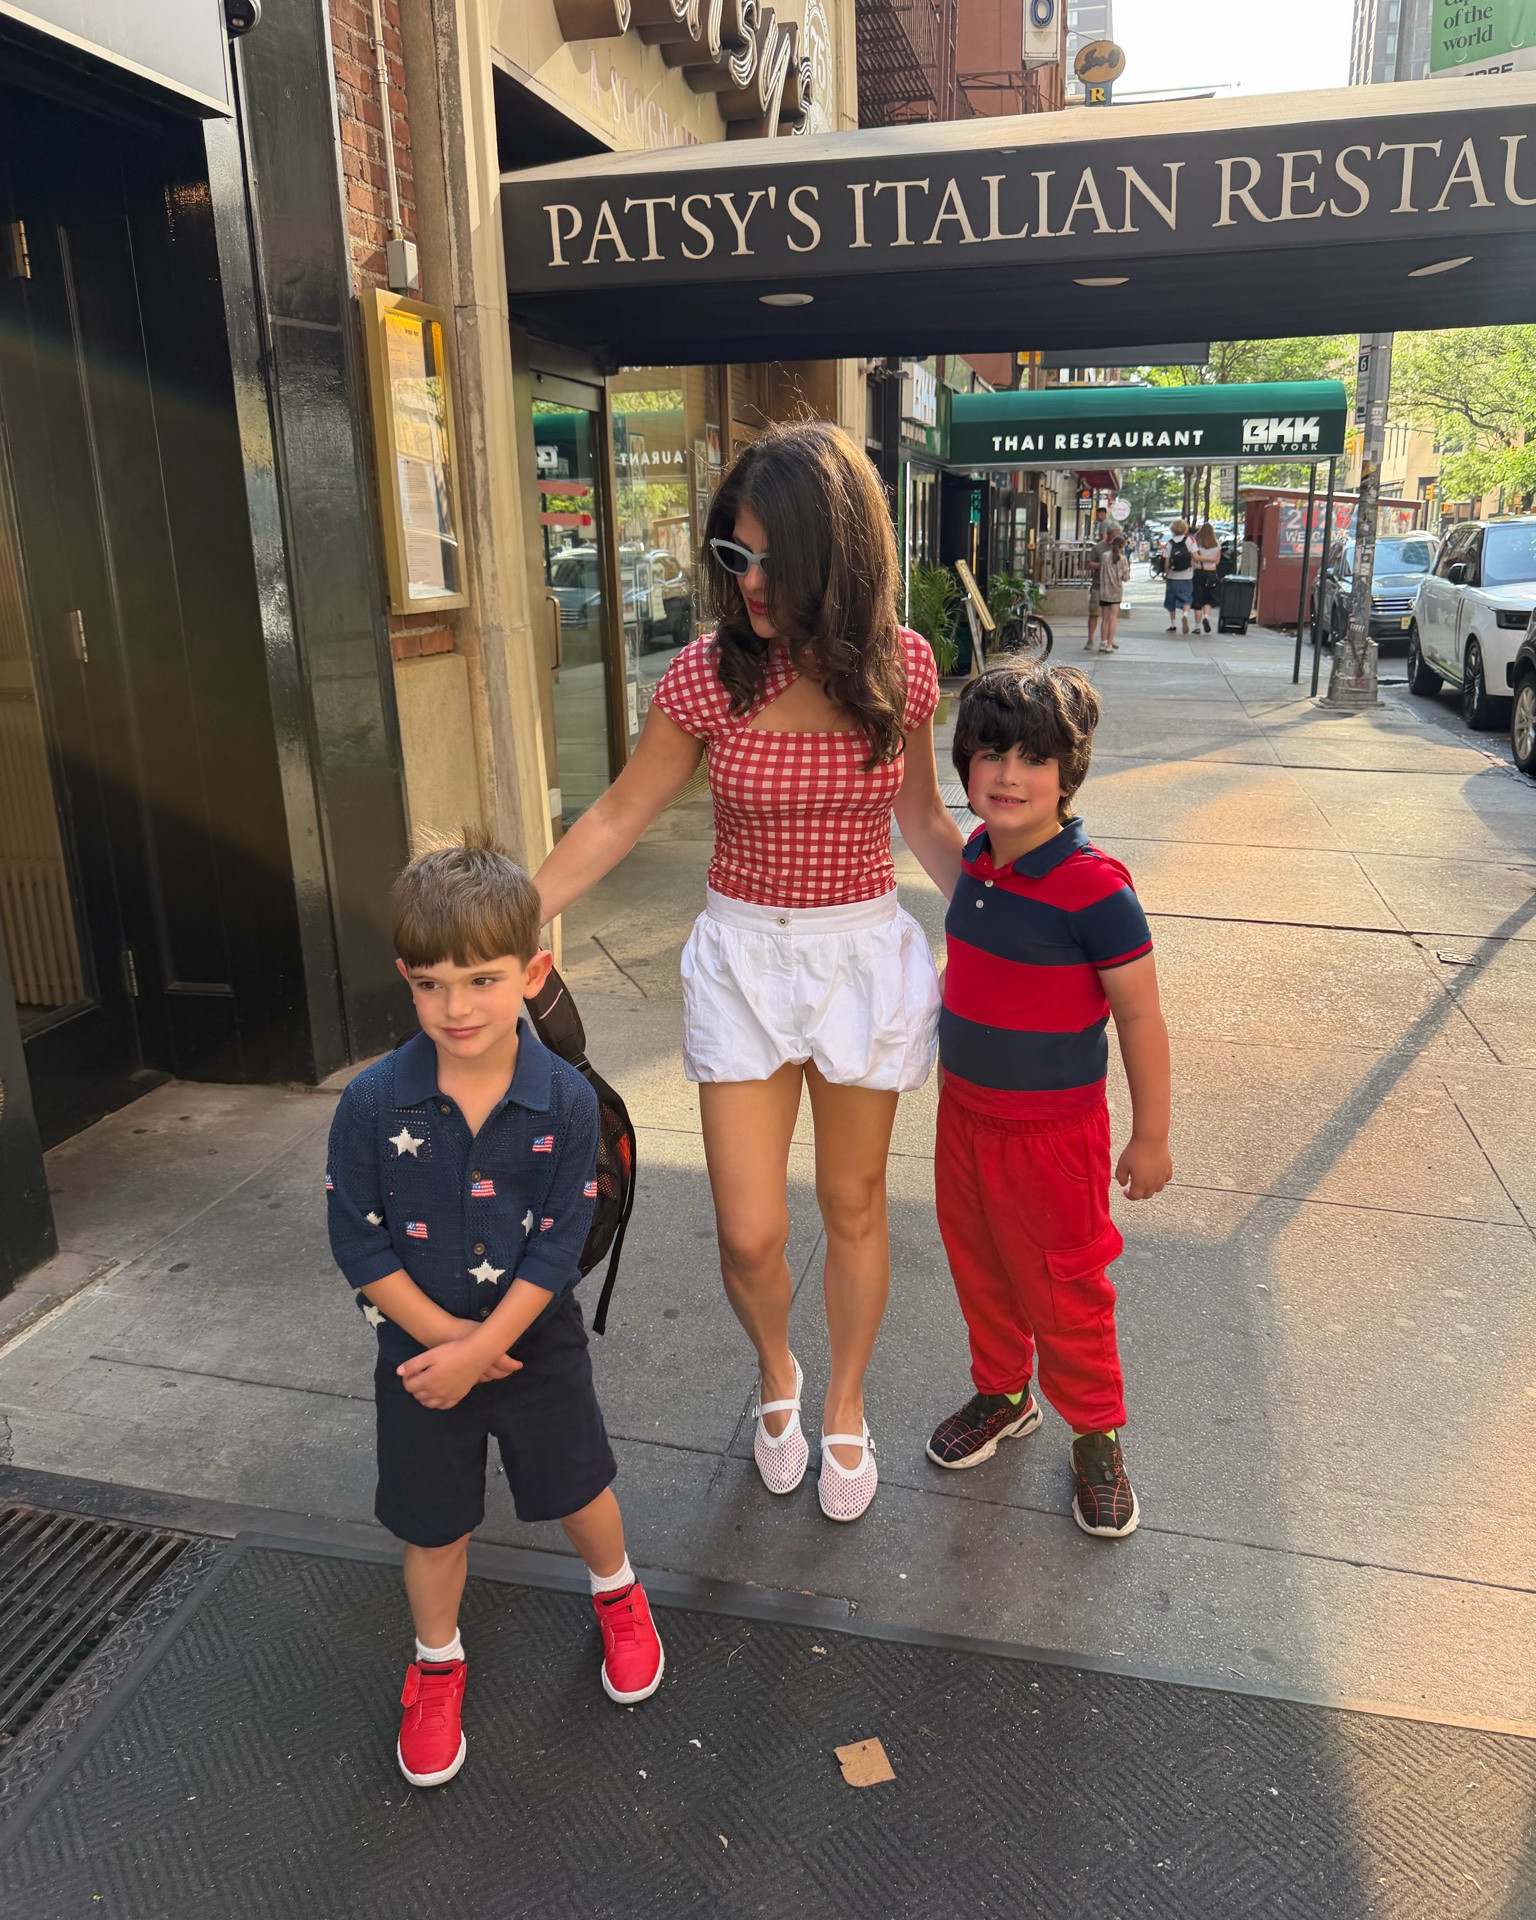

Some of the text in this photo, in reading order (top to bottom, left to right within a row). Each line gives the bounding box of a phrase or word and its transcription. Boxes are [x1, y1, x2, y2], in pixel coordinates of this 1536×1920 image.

[1443, 5, 1493, 29] of the
[1442, 24, 1493, 51] world
[1089, 87, 1106, 102] R
[543, 185, 821, 267] PATSY'S
[847, 162, 1186, 249] ITALIAN
[992, 429, 1204, 451] THAI RESTAURANT
[1242, 416, 1320, 444] BKK
[1242, 442, 1318, 452] NEW YORK
